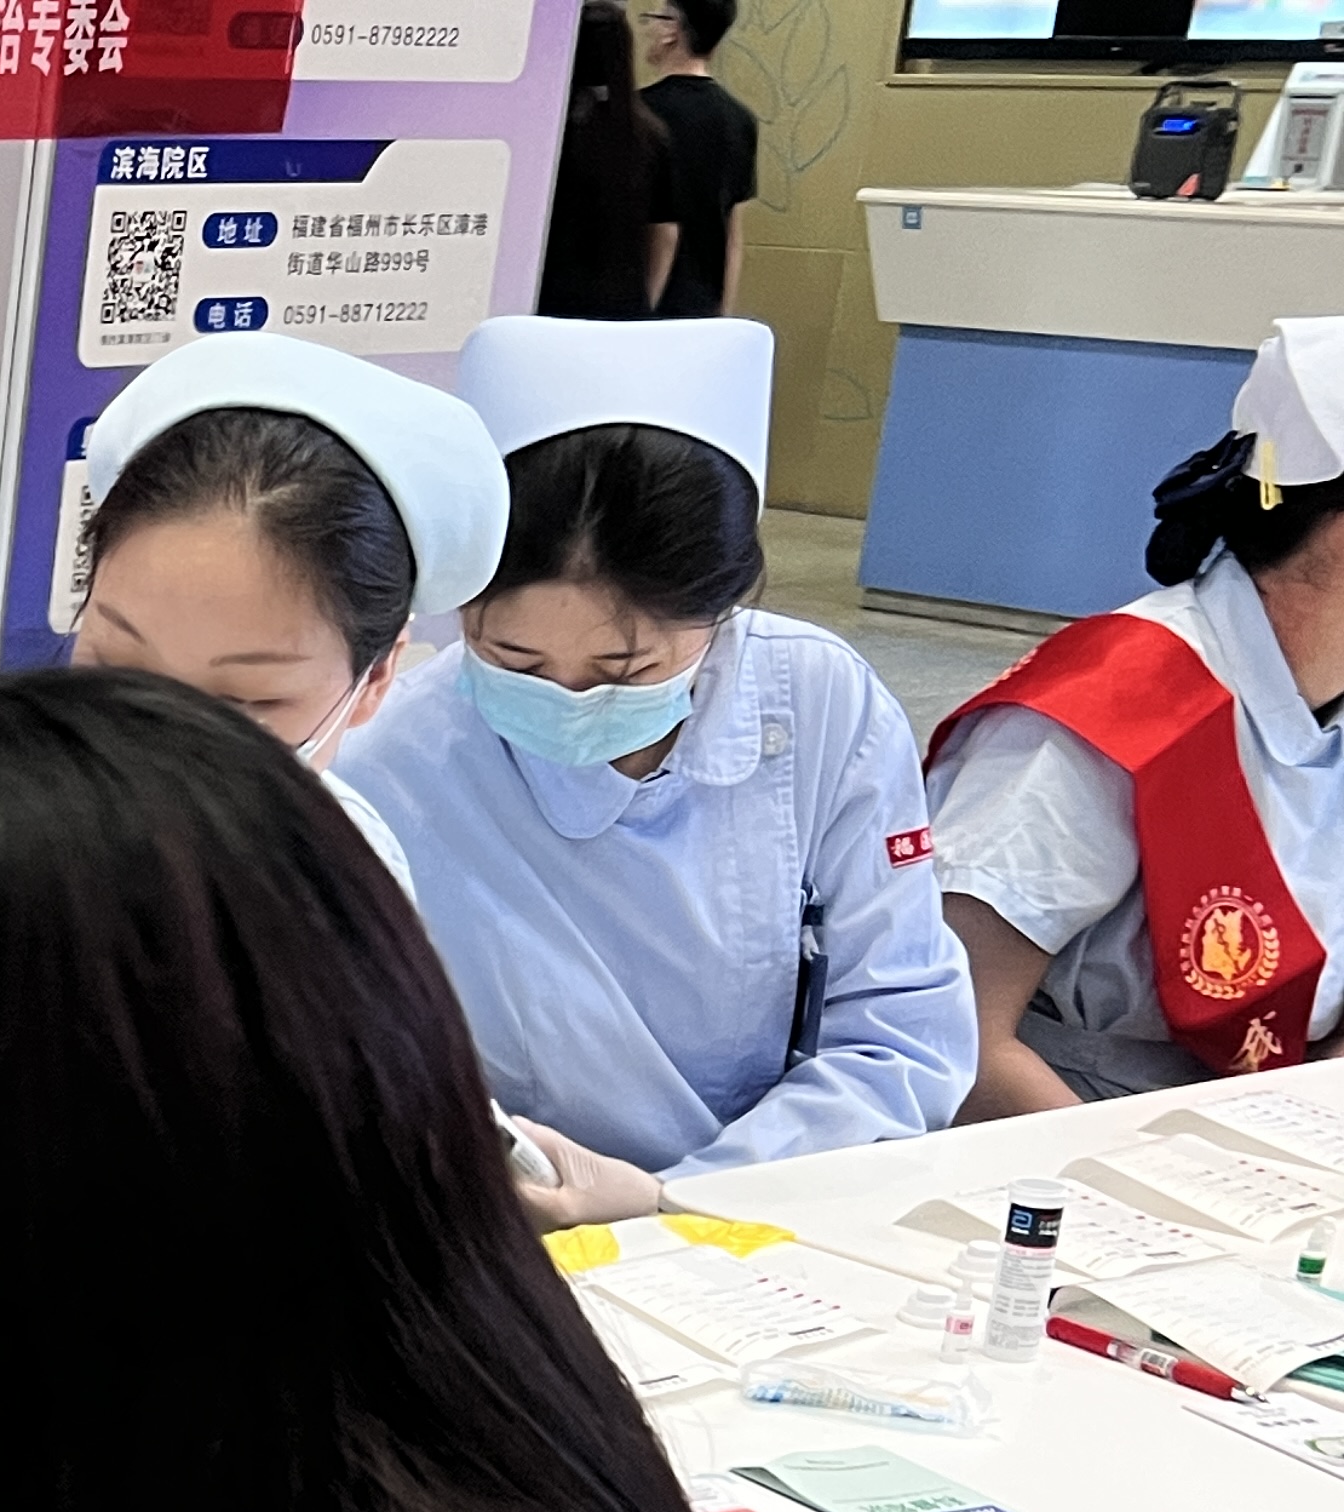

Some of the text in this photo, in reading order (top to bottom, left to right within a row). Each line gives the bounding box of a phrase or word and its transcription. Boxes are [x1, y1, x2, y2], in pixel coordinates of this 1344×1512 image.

[310, 23, 460, 47] 0591-87982222
[110, 146, 210, 181] 滨海院区
[216, 212, 489, 245] 地址 福建省福州市长乐区漳港
[286, 249, 430, 276] 街道华山路999号
[207, 301, 429, 329] 电话 0591-88712222
